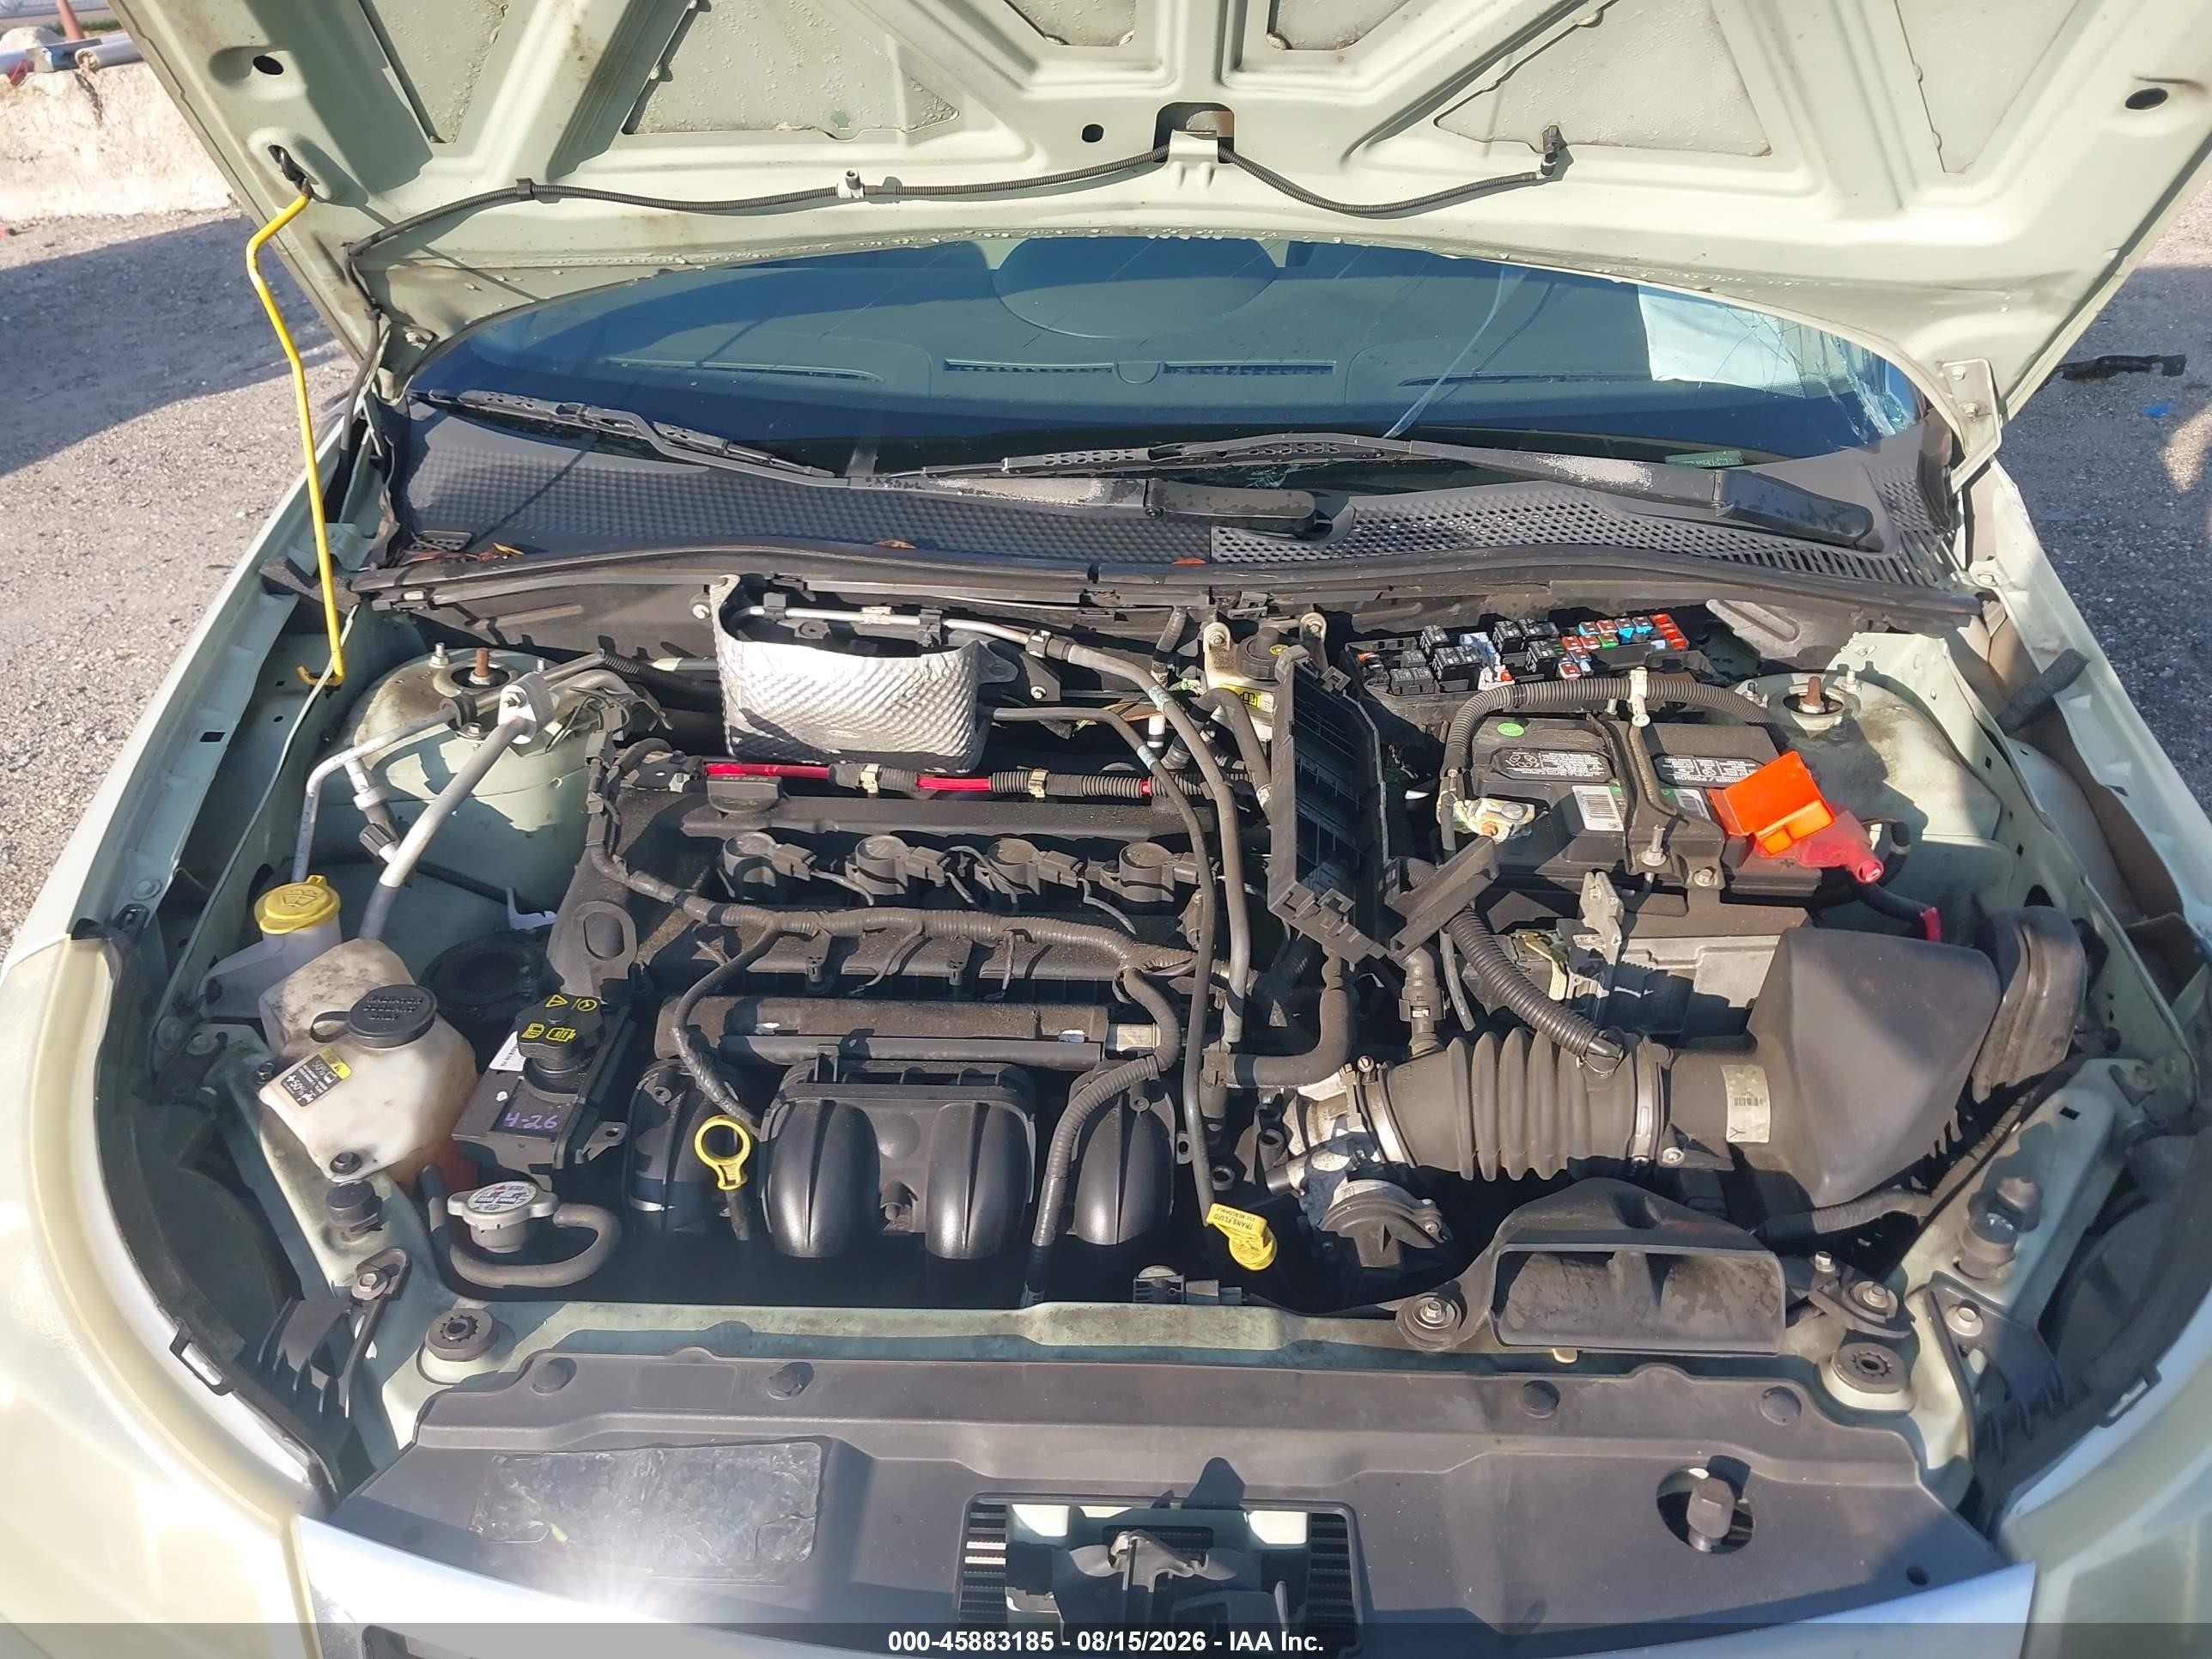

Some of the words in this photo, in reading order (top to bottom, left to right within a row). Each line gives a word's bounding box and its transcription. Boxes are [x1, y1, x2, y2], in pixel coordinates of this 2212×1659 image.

[503, 1112, 559, 1130] 4-26
[1213, 1213, 1232, 1224] FLUID
[1232, 1219, 1254, 1231] TRANS
